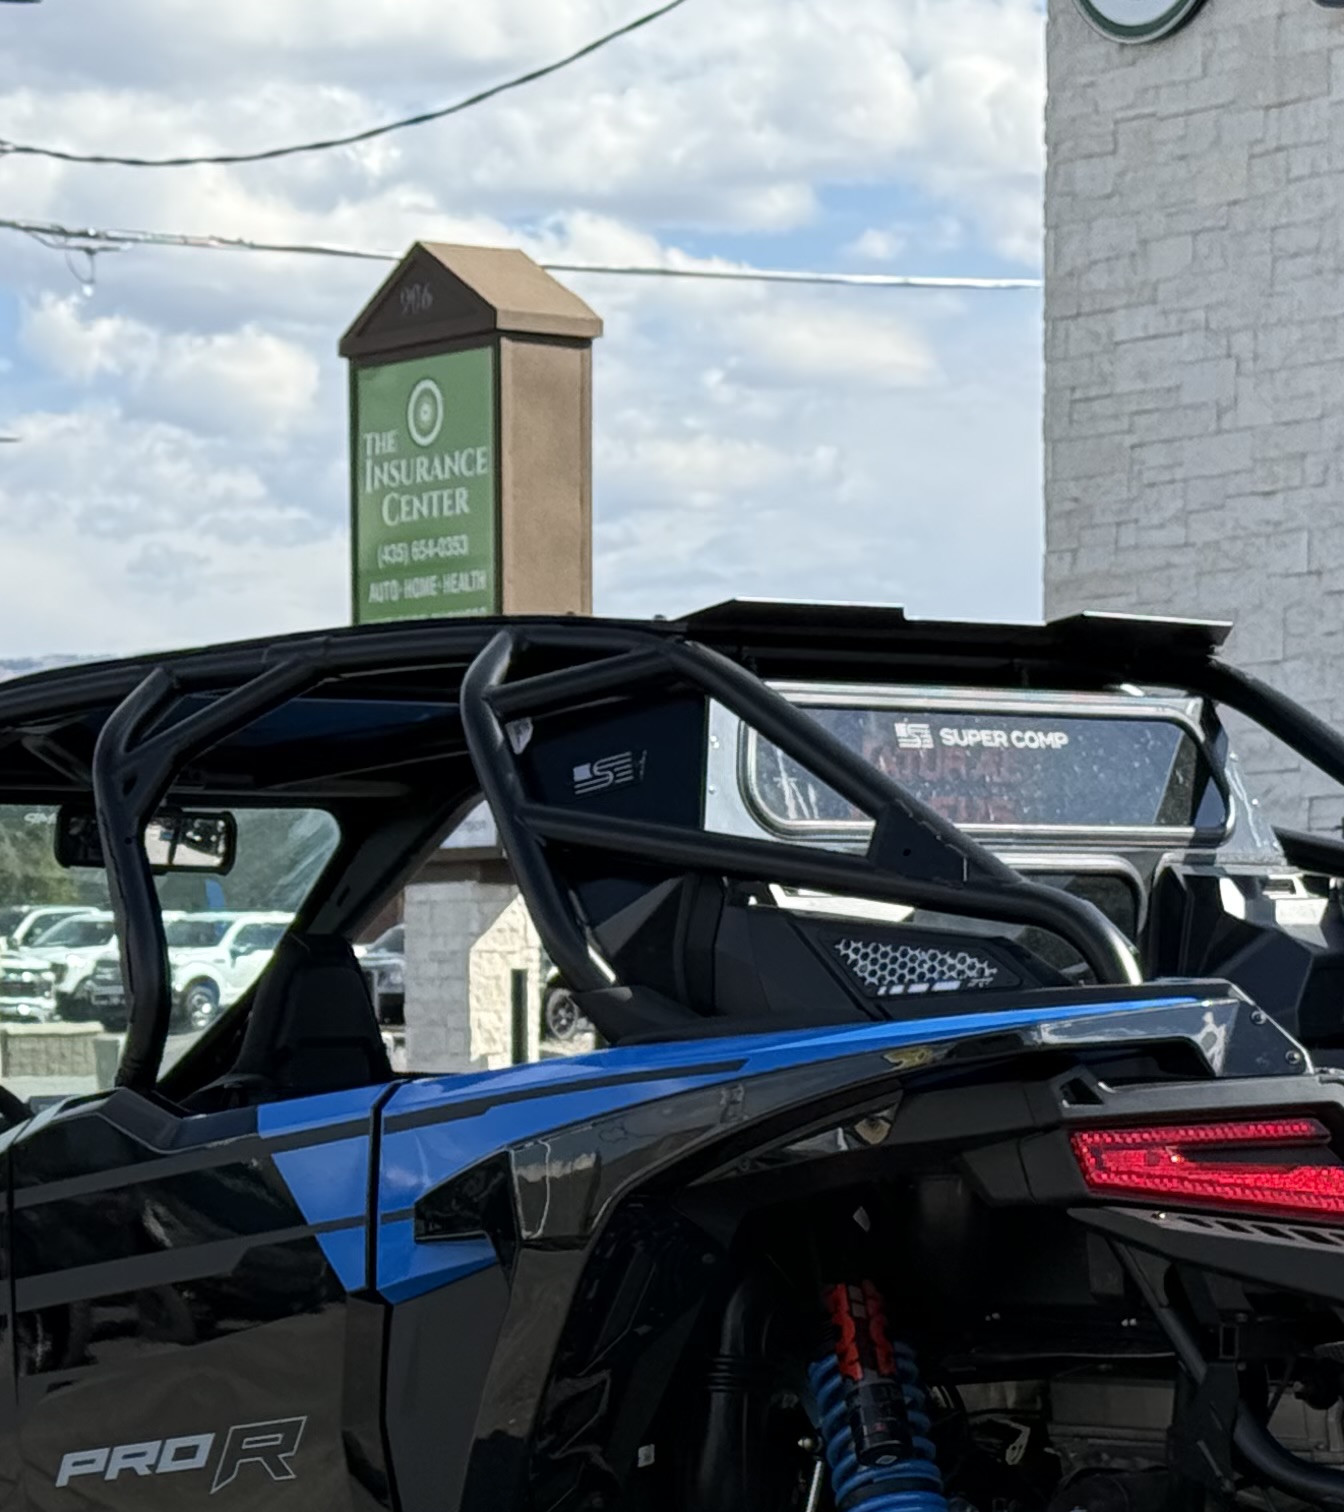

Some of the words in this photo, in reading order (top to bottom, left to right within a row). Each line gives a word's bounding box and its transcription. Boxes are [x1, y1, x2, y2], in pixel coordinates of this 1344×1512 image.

[364, 430, 398, 456] THE
[365, 447, 488, 493] INSURANCE
[382, 487, 470, 526] CENTER
[369, 580, 399, 603] AUTO
[403, 575, 438, 599] HOME
[443, 570, 487, 594] HEALTH
[939, 727, 1009, 748] SUPER
[1011, 729, 1070, 750] COMP
[55, 1432, 216, 1488] PRO
[209, 1415, 308, 1495] R
